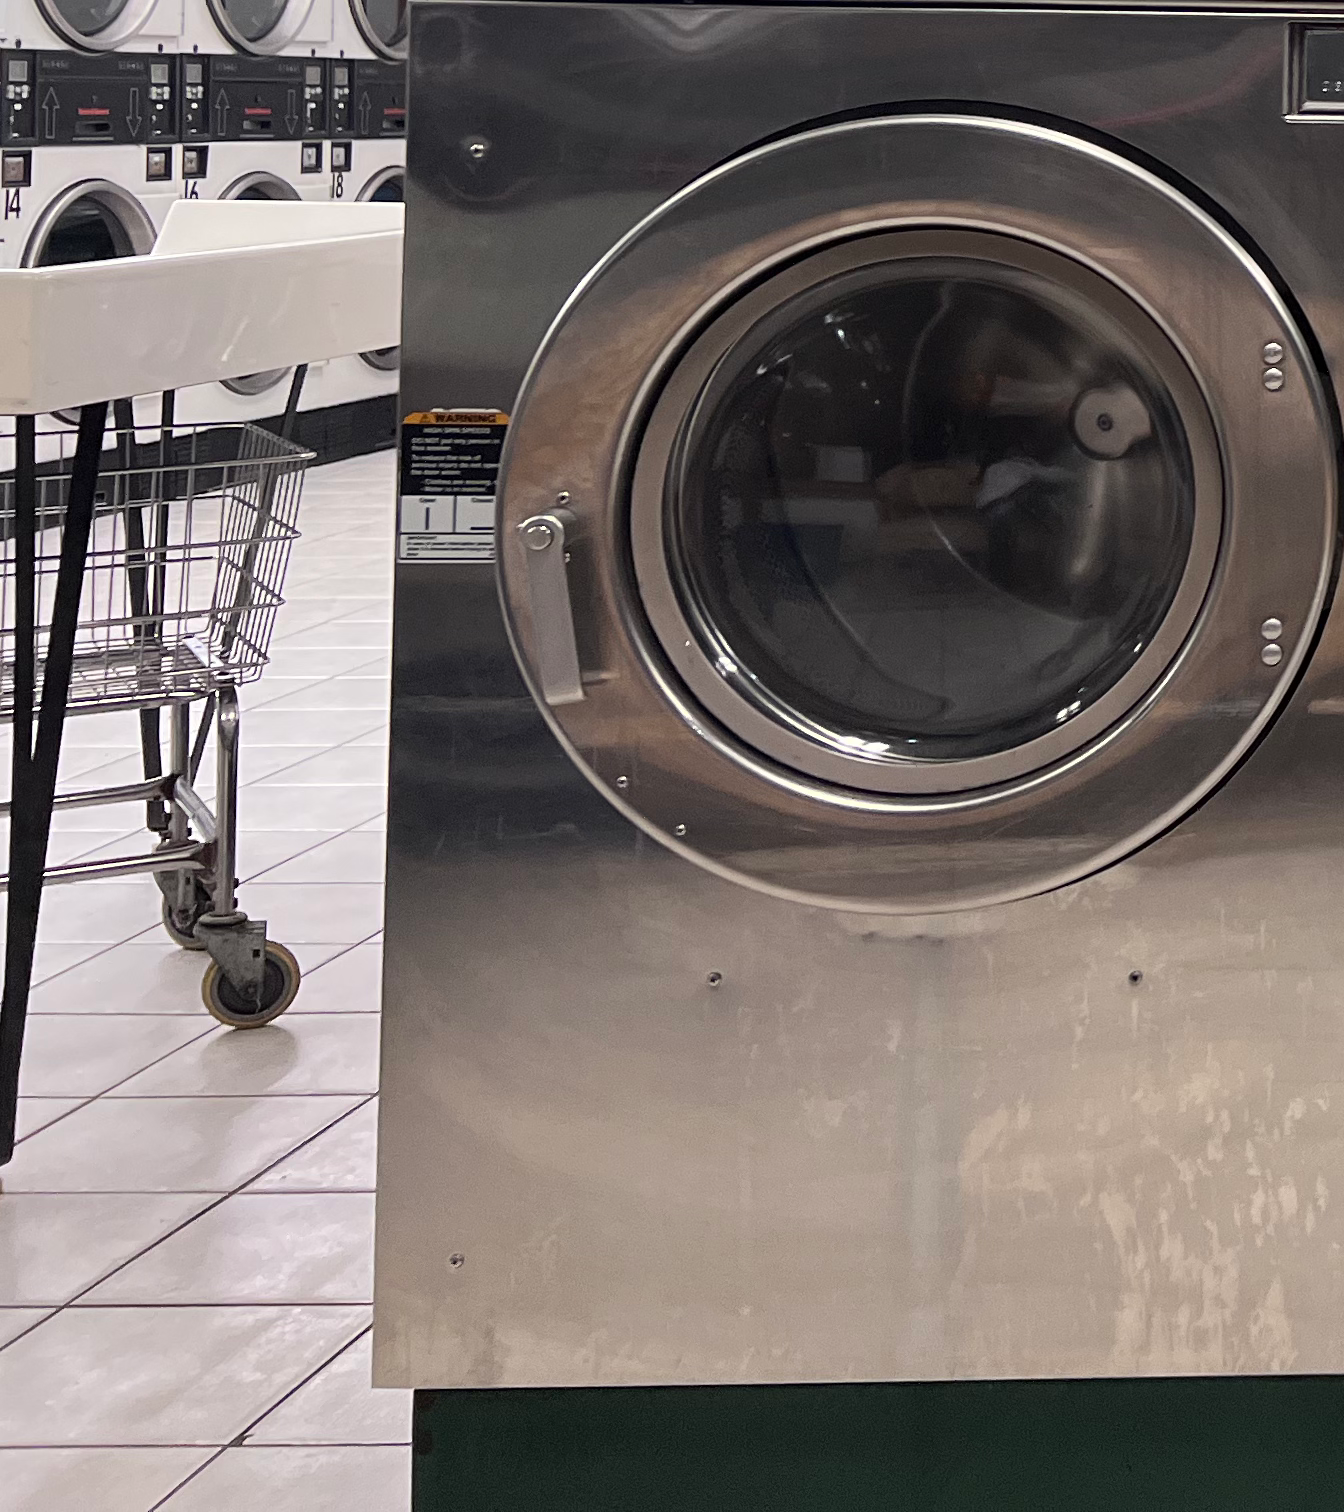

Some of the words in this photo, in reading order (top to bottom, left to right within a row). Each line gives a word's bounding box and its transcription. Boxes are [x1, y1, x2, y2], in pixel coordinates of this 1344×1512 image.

[330, 171, 344, 199] 18
[4, 188, 22, 221] 14
[435, 414, 497, 423] WARNING
